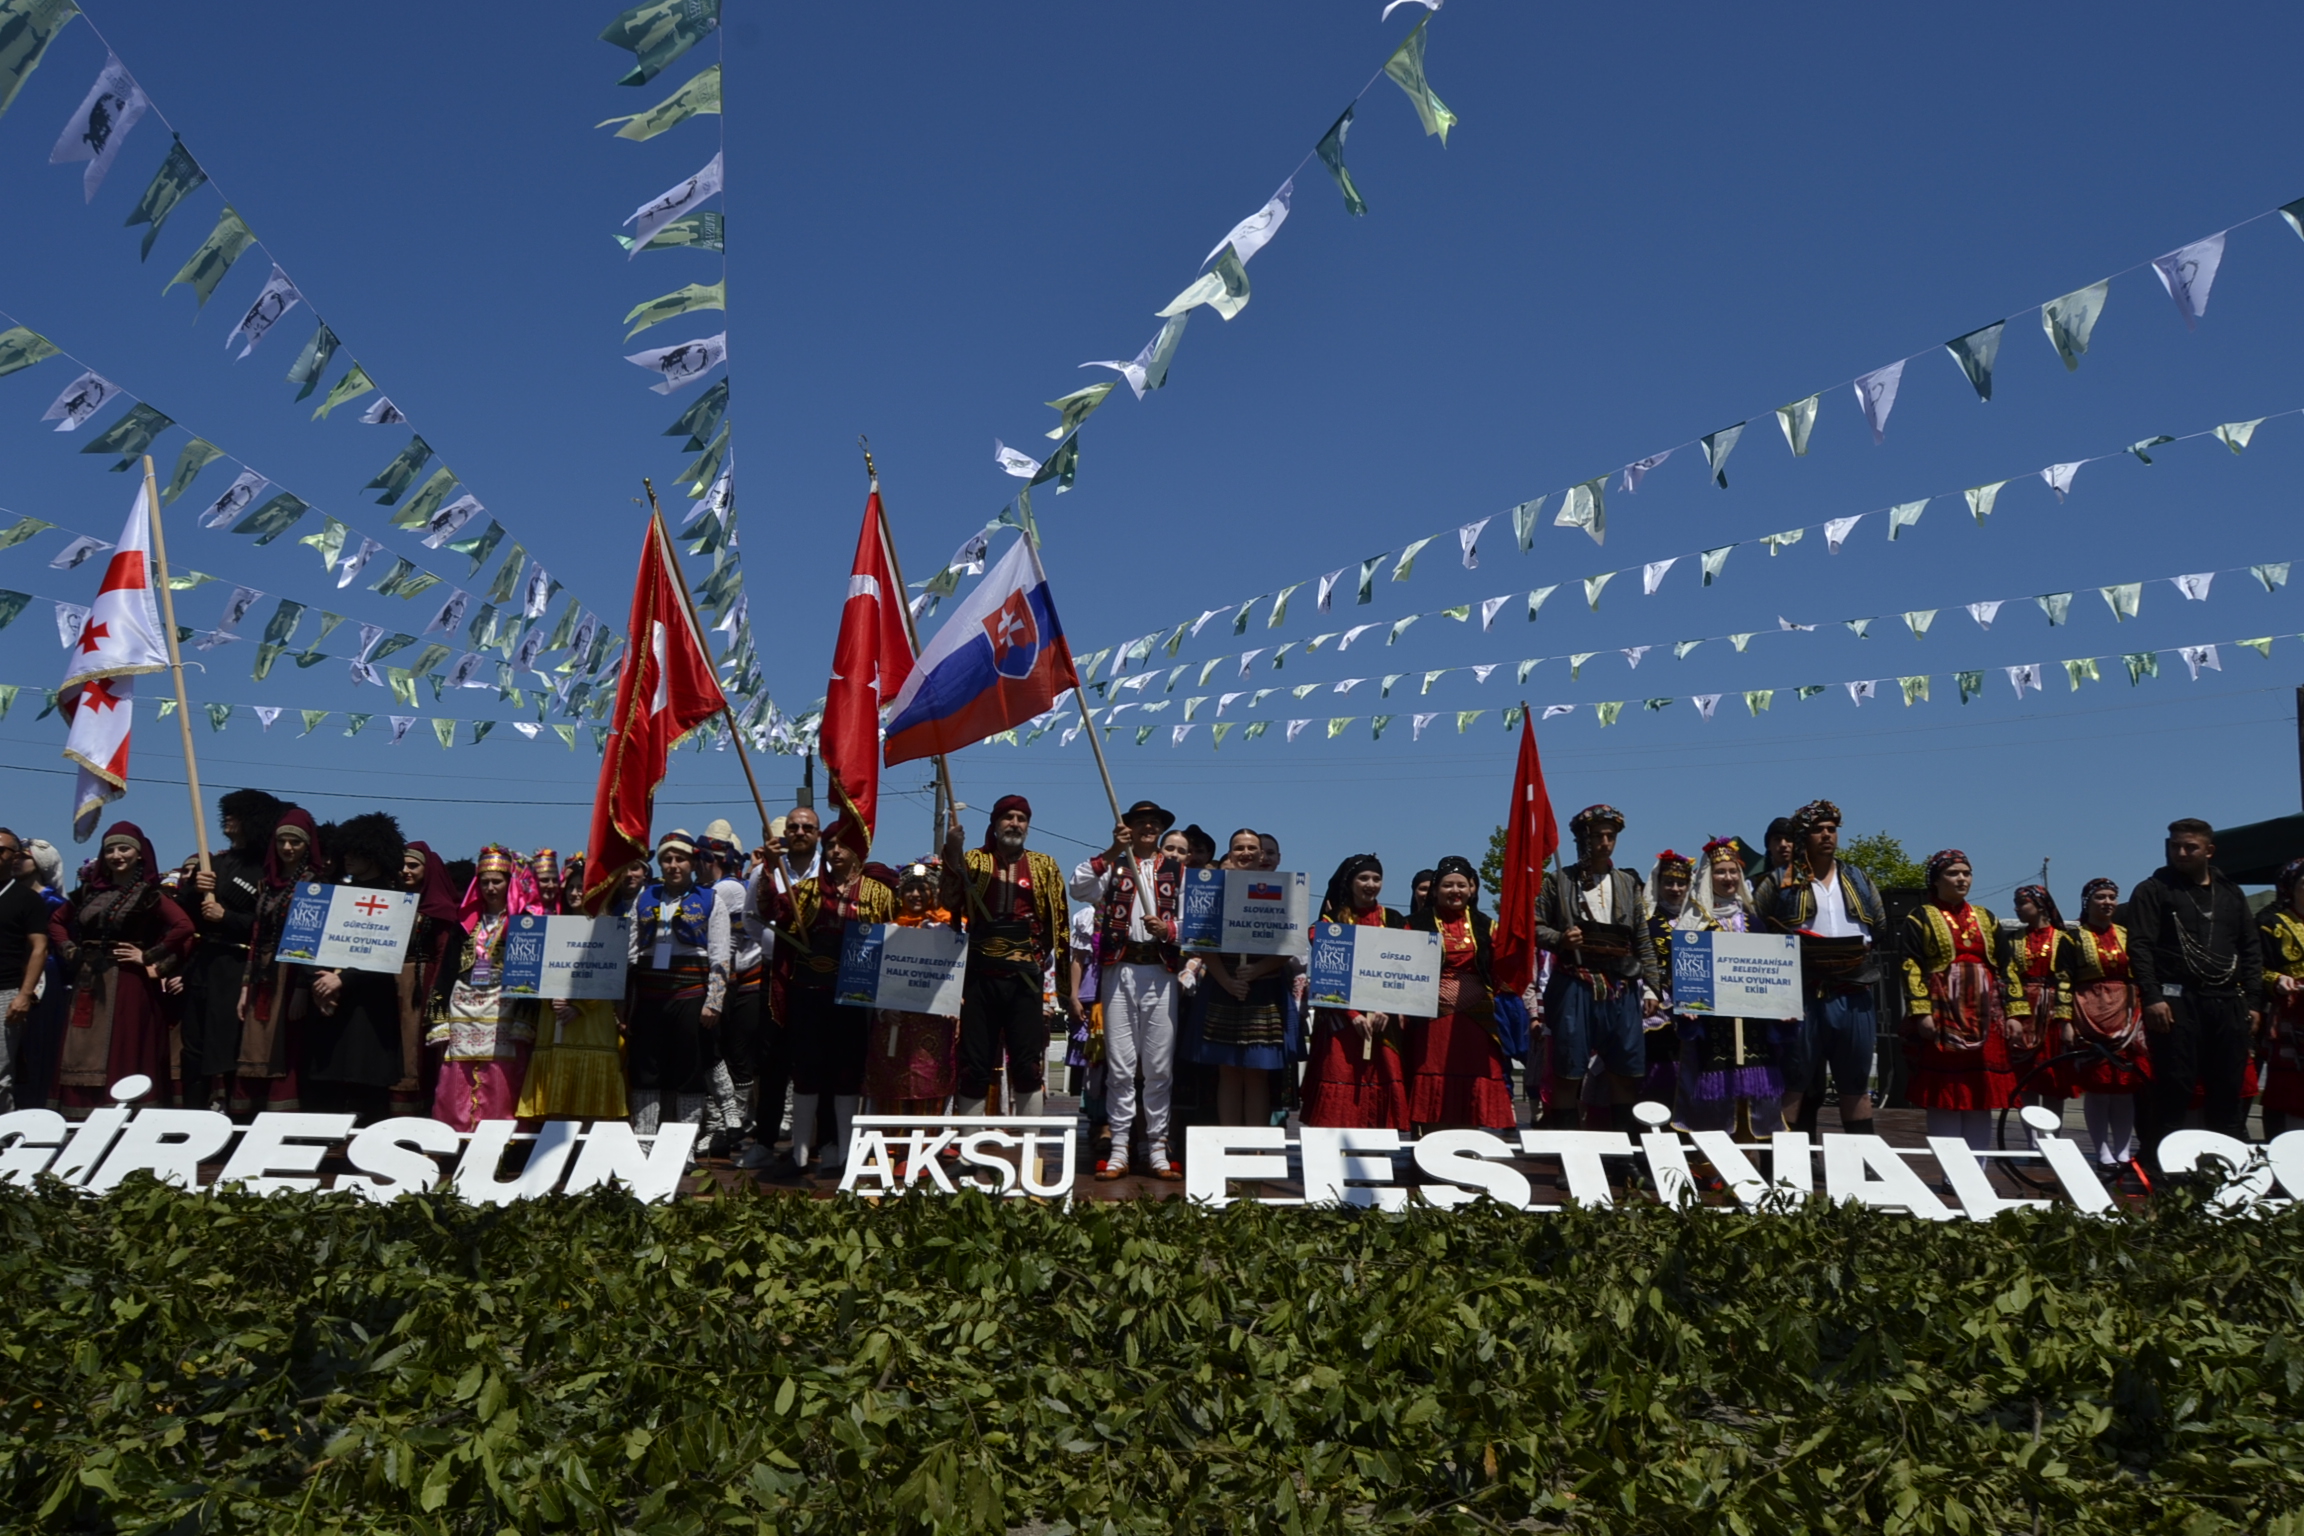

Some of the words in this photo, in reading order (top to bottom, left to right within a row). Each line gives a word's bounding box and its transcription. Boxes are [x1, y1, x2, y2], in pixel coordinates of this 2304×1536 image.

[1243, 906, 1285, 914] SLOVAKYA
[343, 920, 390, 931] GÜRCİSTAN
[1229, 920, 1251, 928] HALK
[1253, 921, 1298, 930] OYUNLARI
[1252, 930, 1274, 938] EKİBİ
[328, 934, 351, 943] HALK
[352, 936, 397, 948] OYUNLARI
[349, 945, 372, 954] EKİBİ
[884, 954, 918, 964] POLATLI
[919, 957, 964, 968] BELEDİYESİ
[1315, 950, 1350, 964] AKSU
[1380, 952, 1411, 961] GİFSAD
[1717, 956, 1794, 966] AFYONKARAHİSAR
[548, 961, 571, 969] HALK
[573, 962, 617, 970] OYUNLARI
[1675, 958, 1710, 971] AKSU
[571, 970, 593, 978] EKİBİ
[886, 967, 908, 977] HALK
[910, 970, 954, 981] OYUNLARI
[1732, 966, 1779, 974] BELEDİYESİ
[1359, 969, 1382, 978] HALK
[1384, 972, 1430, 982] OYUNLARI
[1720, 975, 1744, 984] HALK
[1746, 976, 1791, 986] OYUNLARI
[908, 978, 930, 988] EKİBİ
[1382, 980, 1404, 990] EKİBİ
[1745, 986, 1768, 994] EKİBİ
[0, 1074, 699, 1208] GİRESUN
[837, 1128, 1077, 1197] AKSU
[1185, 1101, 2122, 1222] FESTİVALİ
